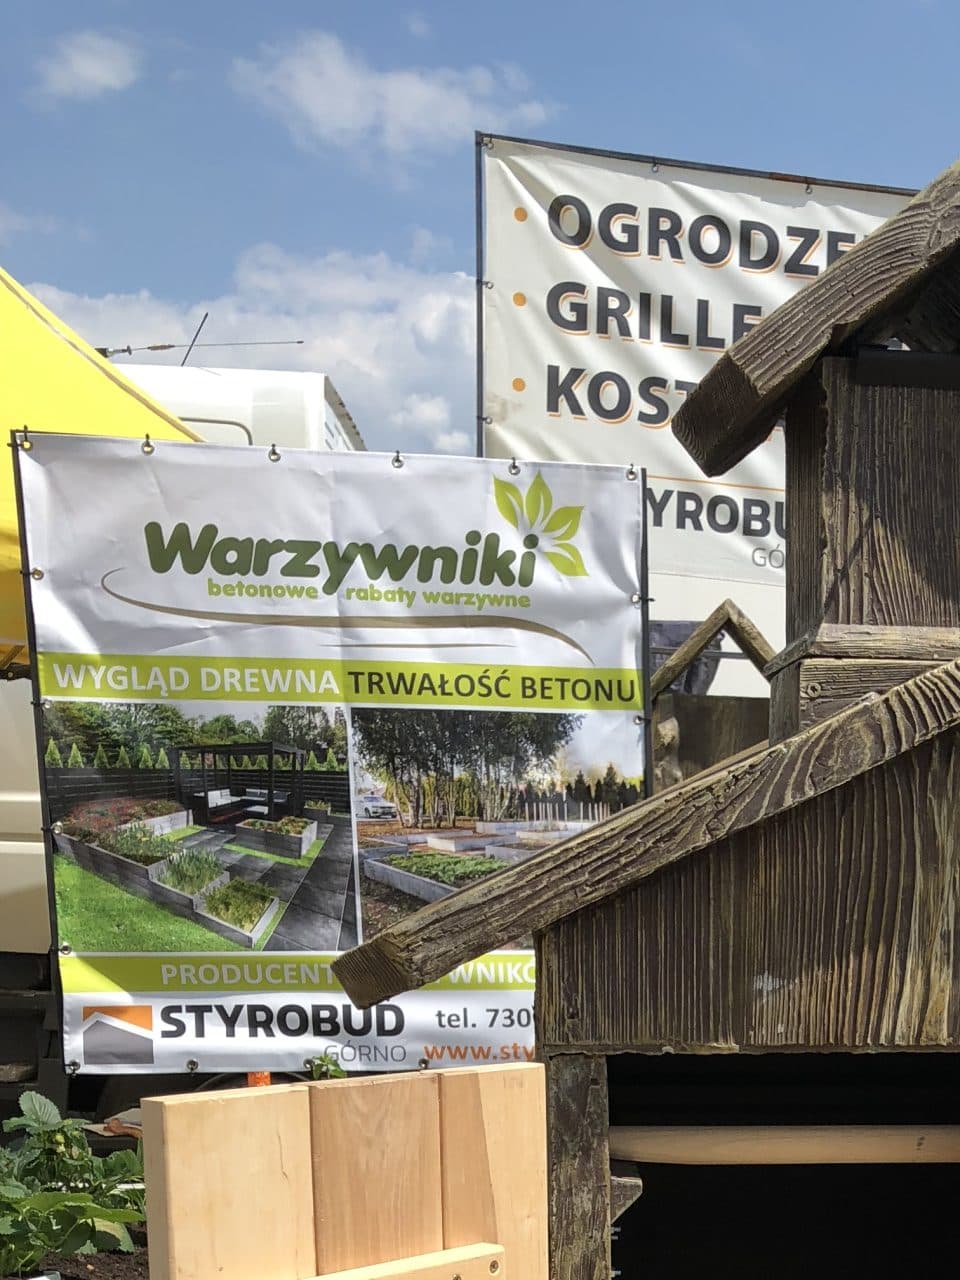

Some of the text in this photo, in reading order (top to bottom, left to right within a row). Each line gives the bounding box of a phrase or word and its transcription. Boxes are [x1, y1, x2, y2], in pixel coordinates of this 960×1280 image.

[547, 194, 857, 277] OGRODZE
[144, 521, 540, 596] Warzywniki
[207, 577, 531, 611] betonowe rabaty warzywne
[52, 663, 636, 702] WYGLĄD DREWNA TRWAŁOŚĆ BETONU
[160, 959, 536, 985] PRODUCENT WNIKÓ
[160, 1004, 531, 1038] STYROBUD tel. 730
[324, 1040, 407, 1062] GÓRNO
